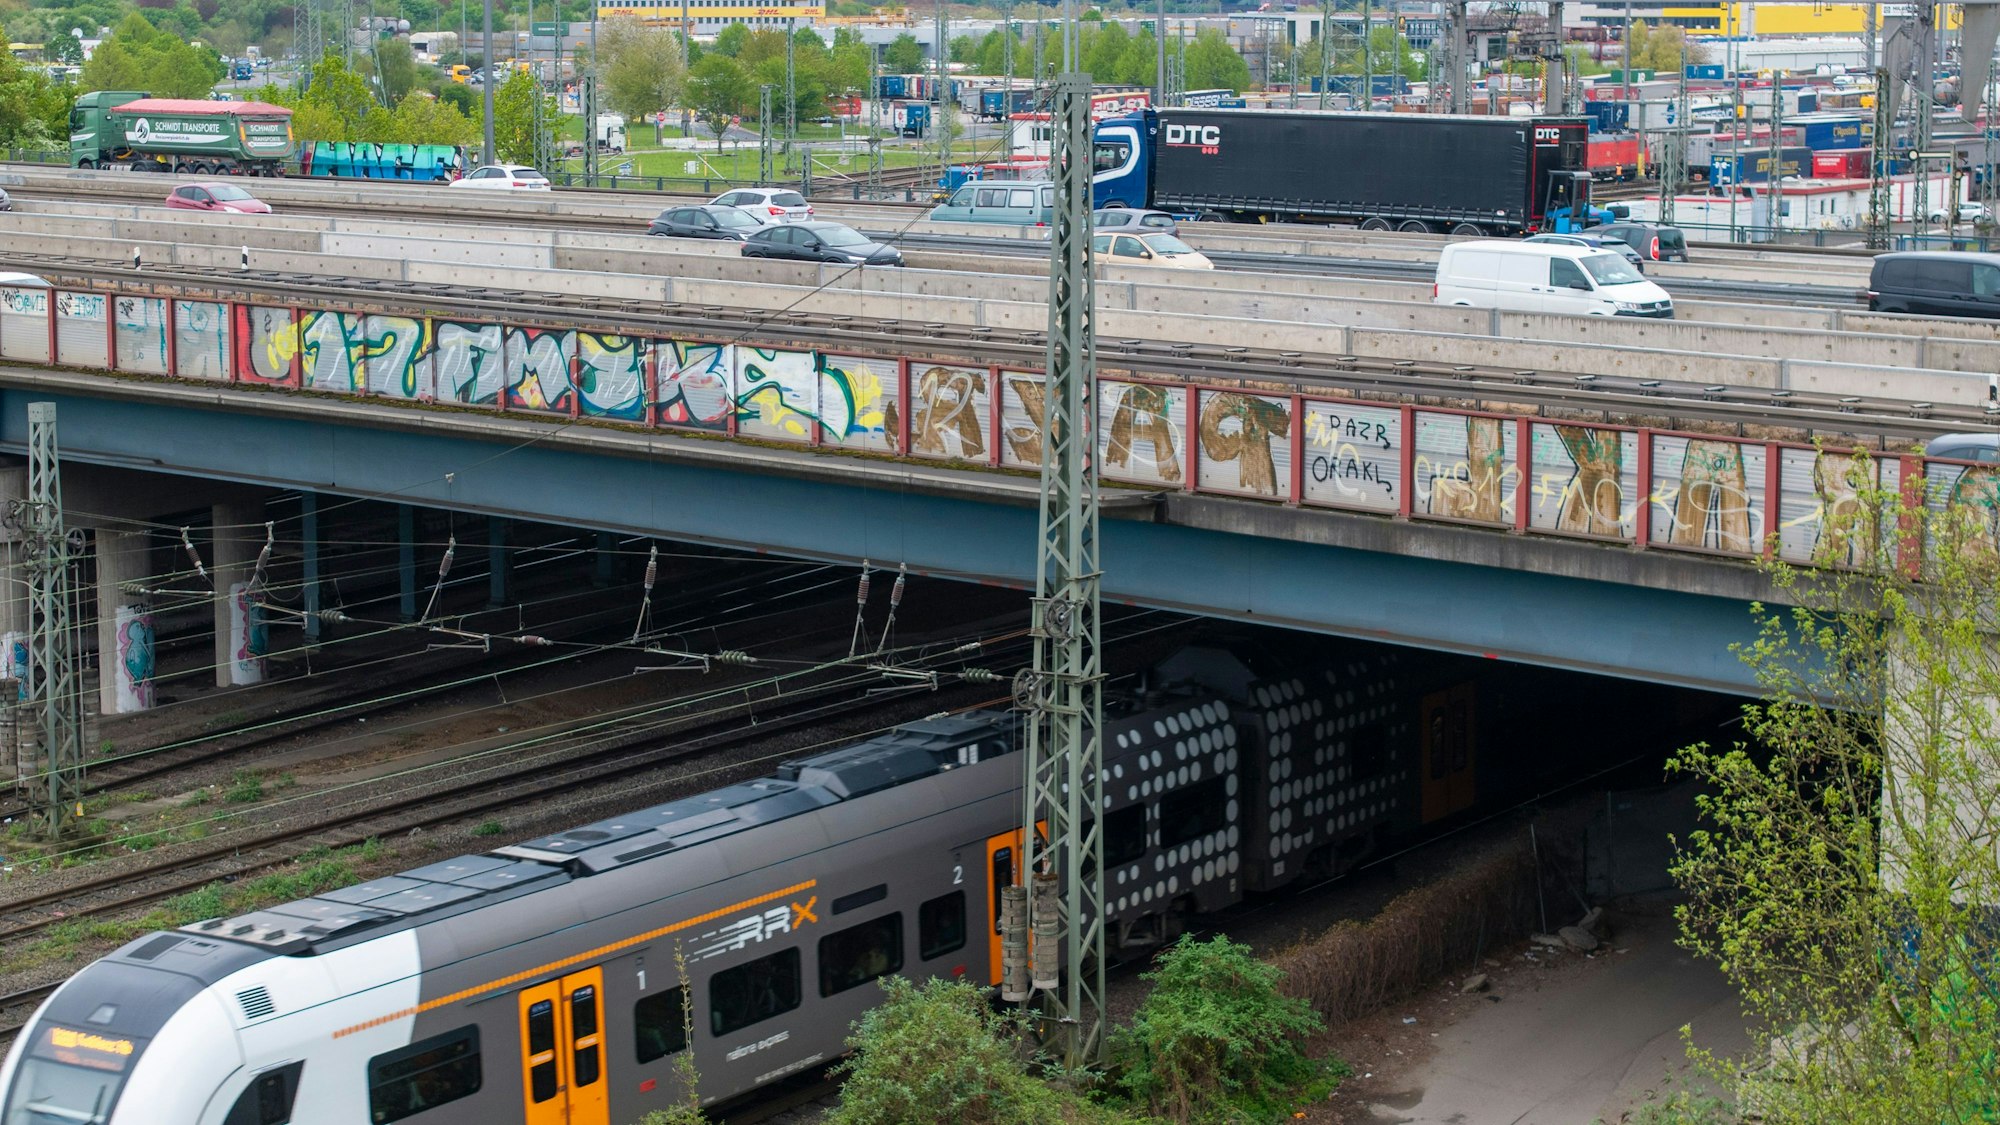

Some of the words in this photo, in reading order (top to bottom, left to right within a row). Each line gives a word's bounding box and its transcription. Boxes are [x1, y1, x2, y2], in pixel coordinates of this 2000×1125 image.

[154, 121, 181, 132] SCHMIDT
[182, 123, 220, 133] TRANSPORTE
[250, 124, 279, 132] SCHMIDT
[1166, 124, 1220, 145] DTC
[1535, 128, 1560, 139] DTC
[952, 865, 963, 885] 2
[636, 970, 647, 990] 1
